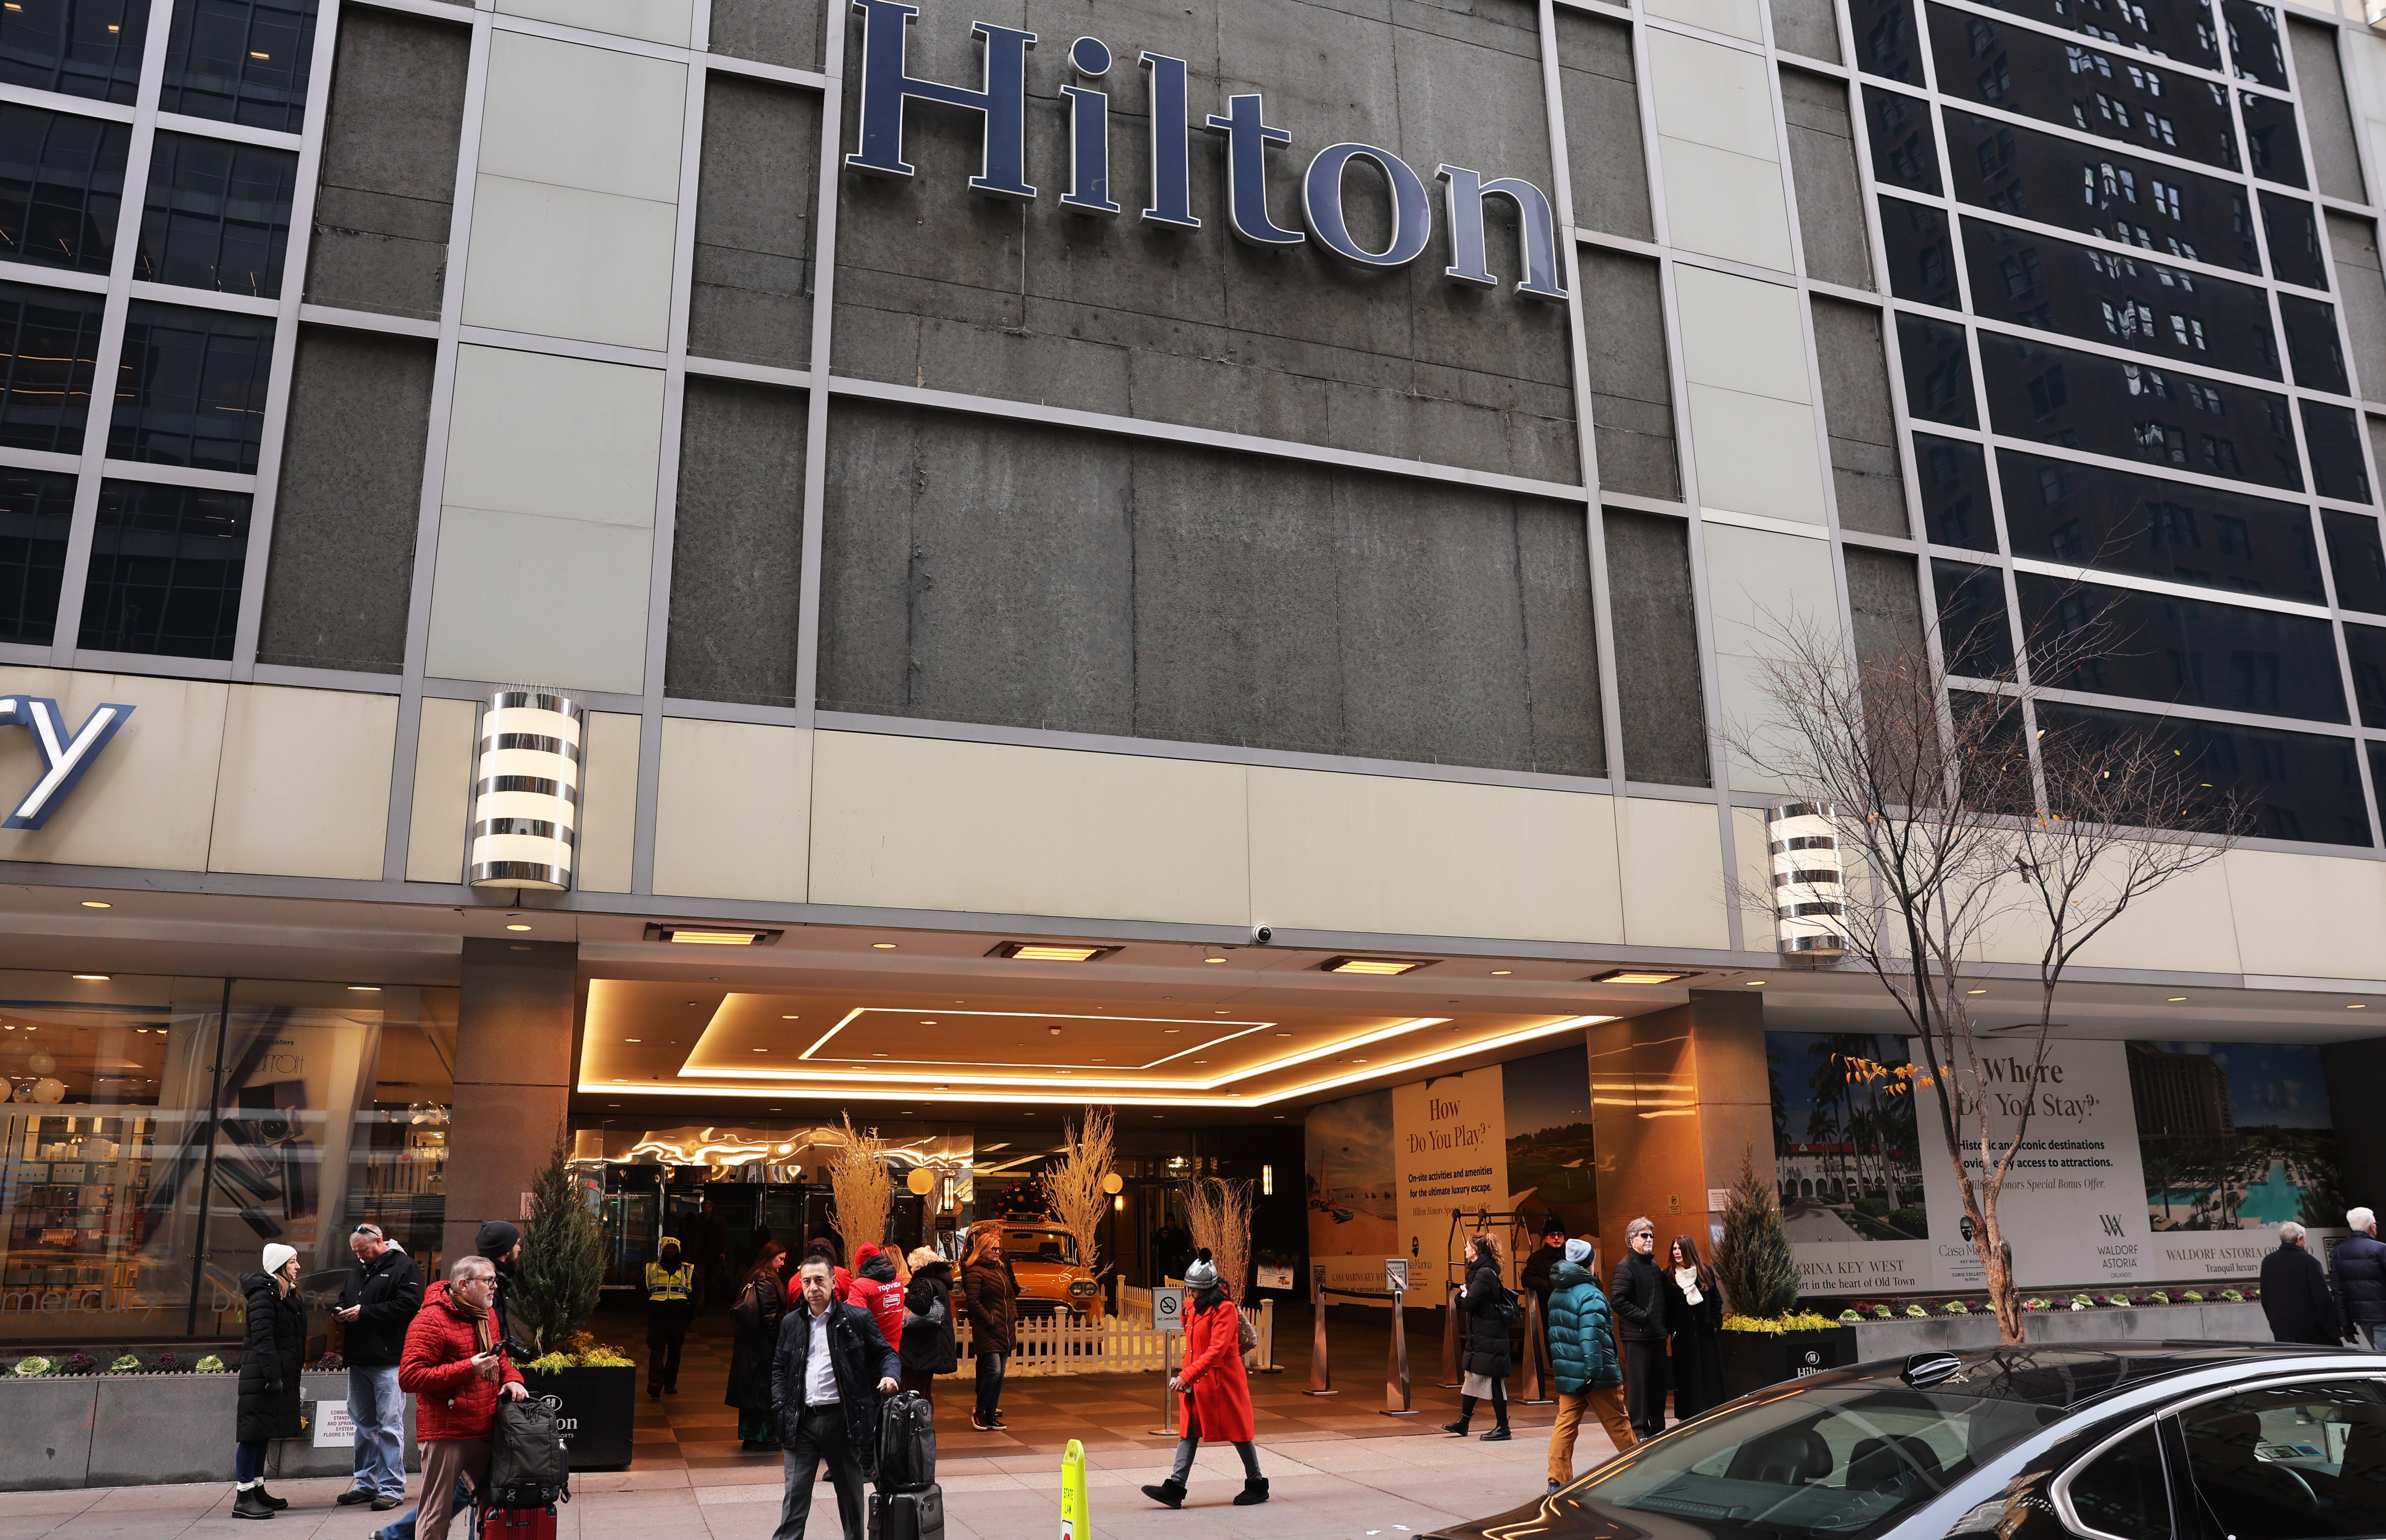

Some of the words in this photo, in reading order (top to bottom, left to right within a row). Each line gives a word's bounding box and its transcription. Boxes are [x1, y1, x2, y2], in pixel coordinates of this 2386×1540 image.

[845, 0, 1568, 303] Hilton
[1429, 1098, 1460, 1121] How
[2042, 1093, 2095, 1124] Stay?
[1410, 1133, 1426, 1153] Do
[1429, 1130, 1451, 1150] You
[1454, 1122, 1486, 1152] Play?
[2048, 1139, 2105, 1150] destinations
[2017, 1159, 2046, 1168] access
[2049, 1158, 2059, 1167] to
[2062, 1157, 2113, 1167] attractions.
[1408, 1174, 1427, 1183] On-site
[1429, 1170, 1452, 1181] activities
[1454, 1168, 1464, 1178] and
[1465, 1166, 1493, 1177] amenities
[1418, 1188, 1427, 1197] the
[1428, 1187, 1450, 1196] ultimate
[1451, 1185, 1470, 1196] luxury
[1471, 1184, 1492, 1194] escape.
[2027, 1179, 2056, 1192] Special
[2059, 1178, 2082, 1189] Bonus
[2084, 1178, 2106, 1190] Offer.
[1413, 1207, 1426, 1216] Hilton
[1427, 1206, 1443, 1216] Honors
[1462, 1204, 1476, 1213] Bonus
[1939, 1245, 1965, 1257] Casa
[2097, 1245, 2138, 1255] WALDORF
[2166, 1248, 2216, 1260] WALDORF
[2219, 1247, 2262, 1260] ASTORIA
[1415, 1259, 1432, 1269] Marina
[1795, 1262, 1833, 1275] ARINA
[1838, 1262, 1864, 1274] KEY
[1869, 1260, 1904, 1272] WEST
[2103, 1258, 2137, 1268] ASTORIA
[2205, 1263, 2235, 1274] Tranquil
[2237, 1262, 2259, 1273] luxury
[1332, 1273, 1344, 1281] CASA
[1345, 1273, 1364, 1281] MARINA
[1364, 1273, 1374, 1281] KEY
[1376, 1273, 1385, 1281] WES
[1812, 1280, 1820, 1290] in
[1822, 1279, 1836, 1289] the
[1839, 1279, 1861, 1288] heart
[1864, 1278, 1872, 1287] of
[1875, 1277, 1890, 1287] Old
[1893, 1277, 1916, 1286] Town
[1064, 1488, 1073, 1501] STATE
